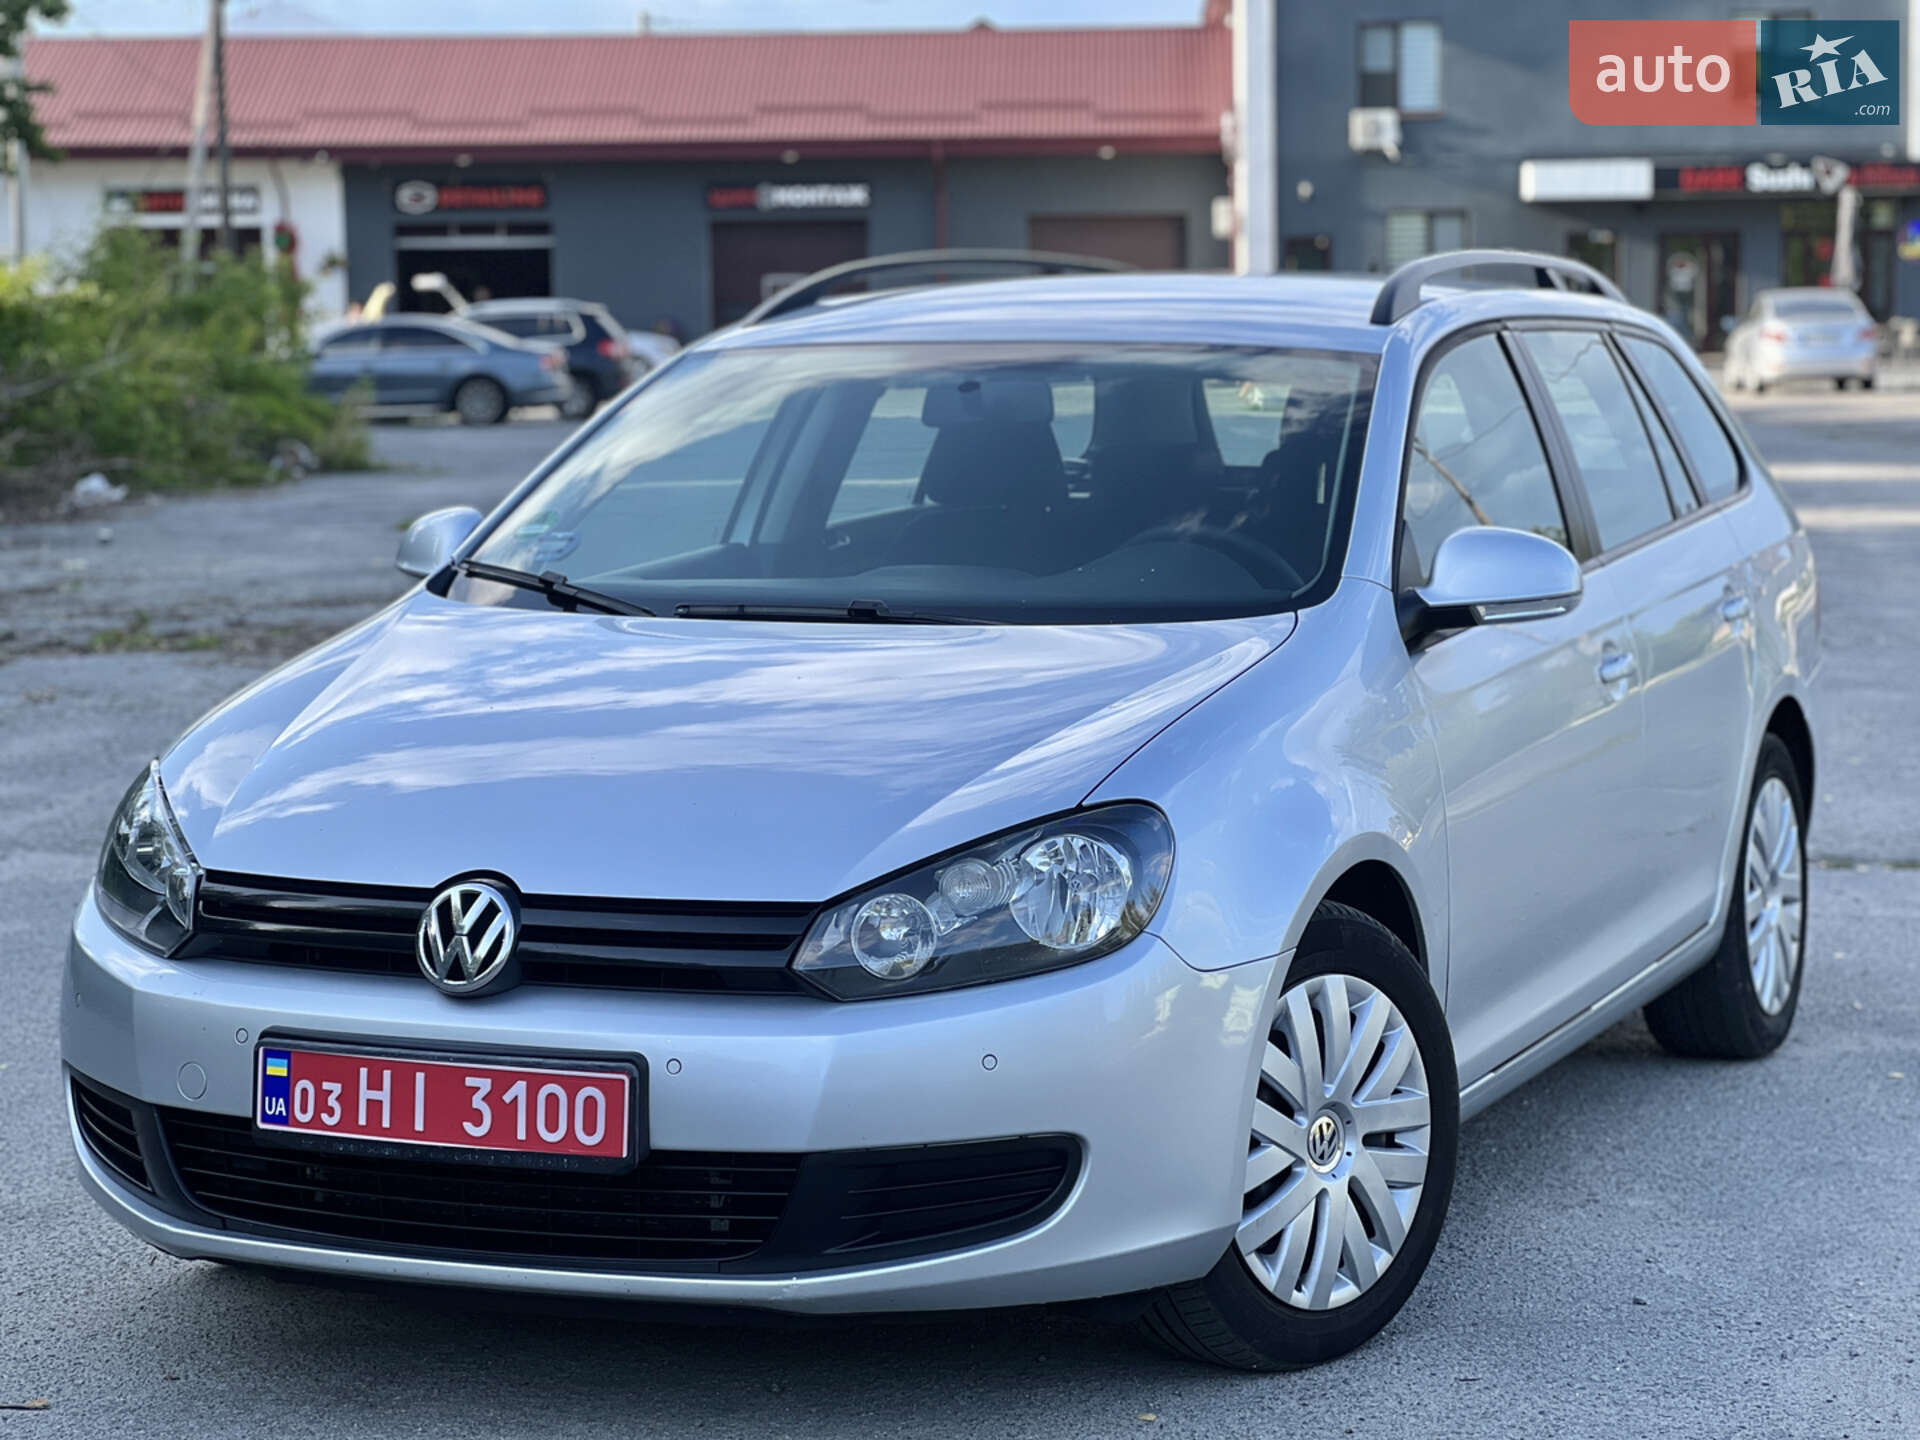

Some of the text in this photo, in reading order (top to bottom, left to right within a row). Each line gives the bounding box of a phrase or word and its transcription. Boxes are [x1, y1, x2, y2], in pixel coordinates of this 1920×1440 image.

[264, 1096, 287, 1117] UA
[293, 1079, 342, 1127] 03
[462, 1076, 606, 1147] 3100
